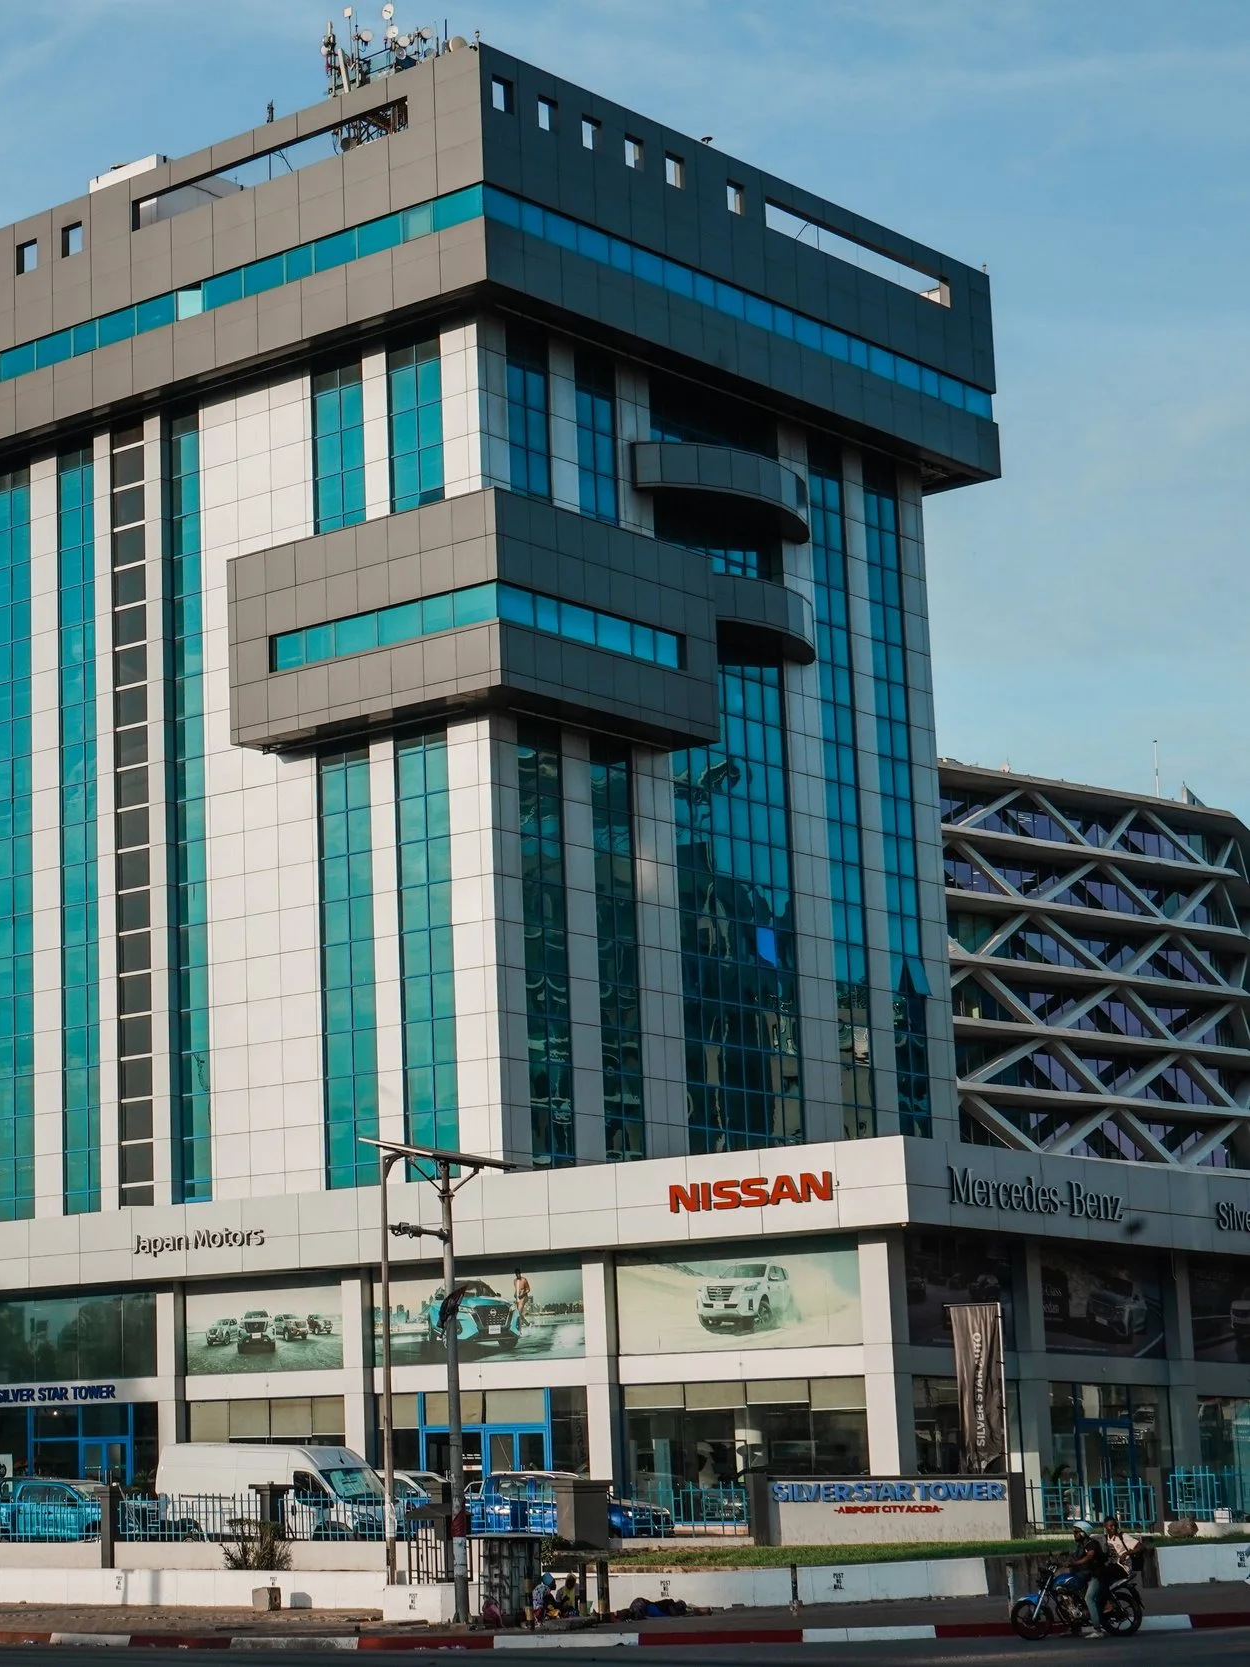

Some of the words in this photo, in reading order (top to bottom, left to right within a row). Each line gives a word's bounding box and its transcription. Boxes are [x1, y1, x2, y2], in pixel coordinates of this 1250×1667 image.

[669, 1171, 833, 1213] NISSAN
[947, 1165, 1123, 1222] Mercedes-Benz
[134, 1235, 190, 1258] Japan
[193, 1227, 265, 1249] Motors
[38, 1387, 69, 1402] STAR
[71, 1384, 116, 1400] TOWER
[976, 1407, 986, 1447] SILVER
[774, 1481, 853, 1502] SILVER
[854, 1481, 913, 1502] STAR
[915, 1480, 1006, 1502] TOWER
[882, 1505, 904, 1513] CITY
